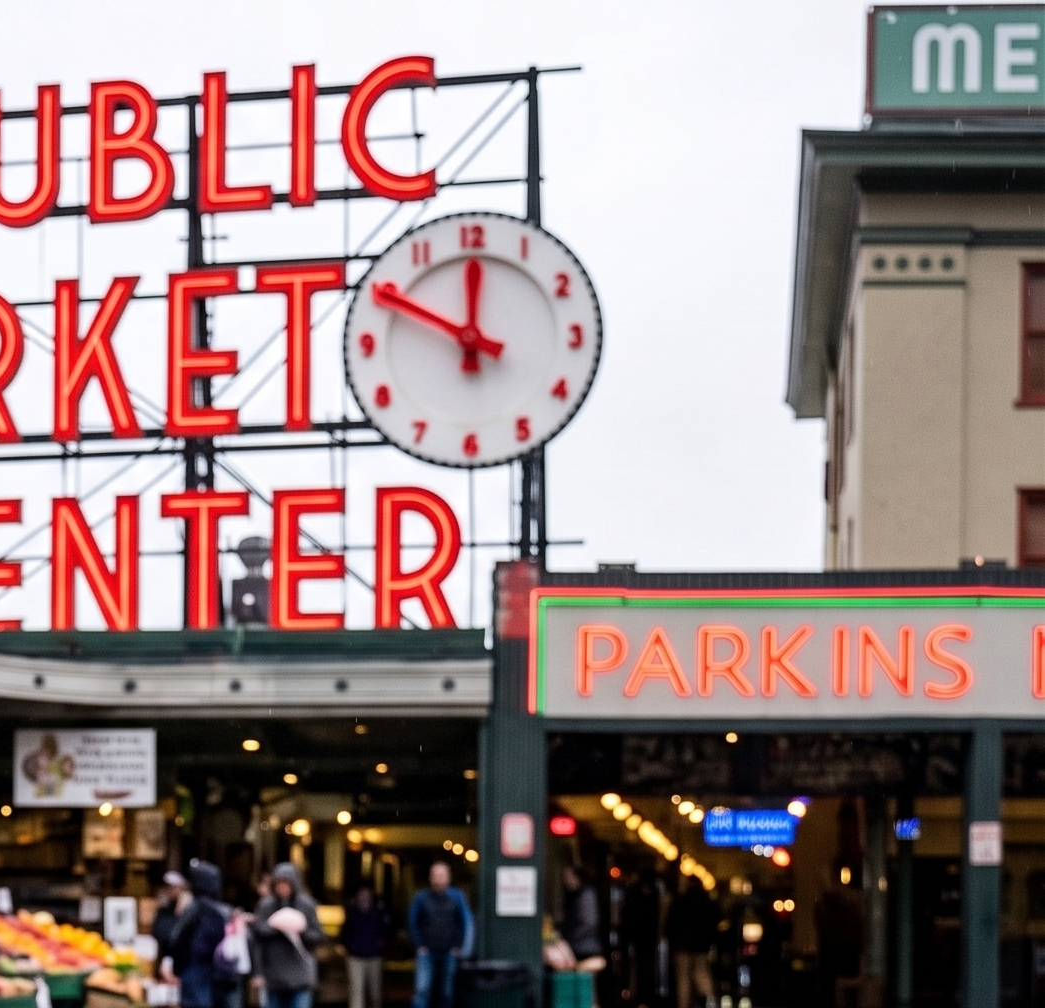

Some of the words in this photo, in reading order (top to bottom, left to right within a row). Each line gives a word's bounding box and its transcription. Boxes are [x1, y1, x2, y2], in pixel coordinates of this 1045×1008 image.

[459, 225, 485, 249] 12
[520, 236, 529, 260] 1
[412, 241, 430, 267] 11
[554, 273, 570, 298] 2
[359, 333, 376, 358] 9
[568, 324, 584, 350] 3
[374, 385, 392, 409] 8
[550, 378, 568, 401] 4
[412, 420, 428, 444] 7
[515, 416, 531, 442] 5
[462, 432, 480, 457] 6
[575, 622, 975, 700] PARKINS
